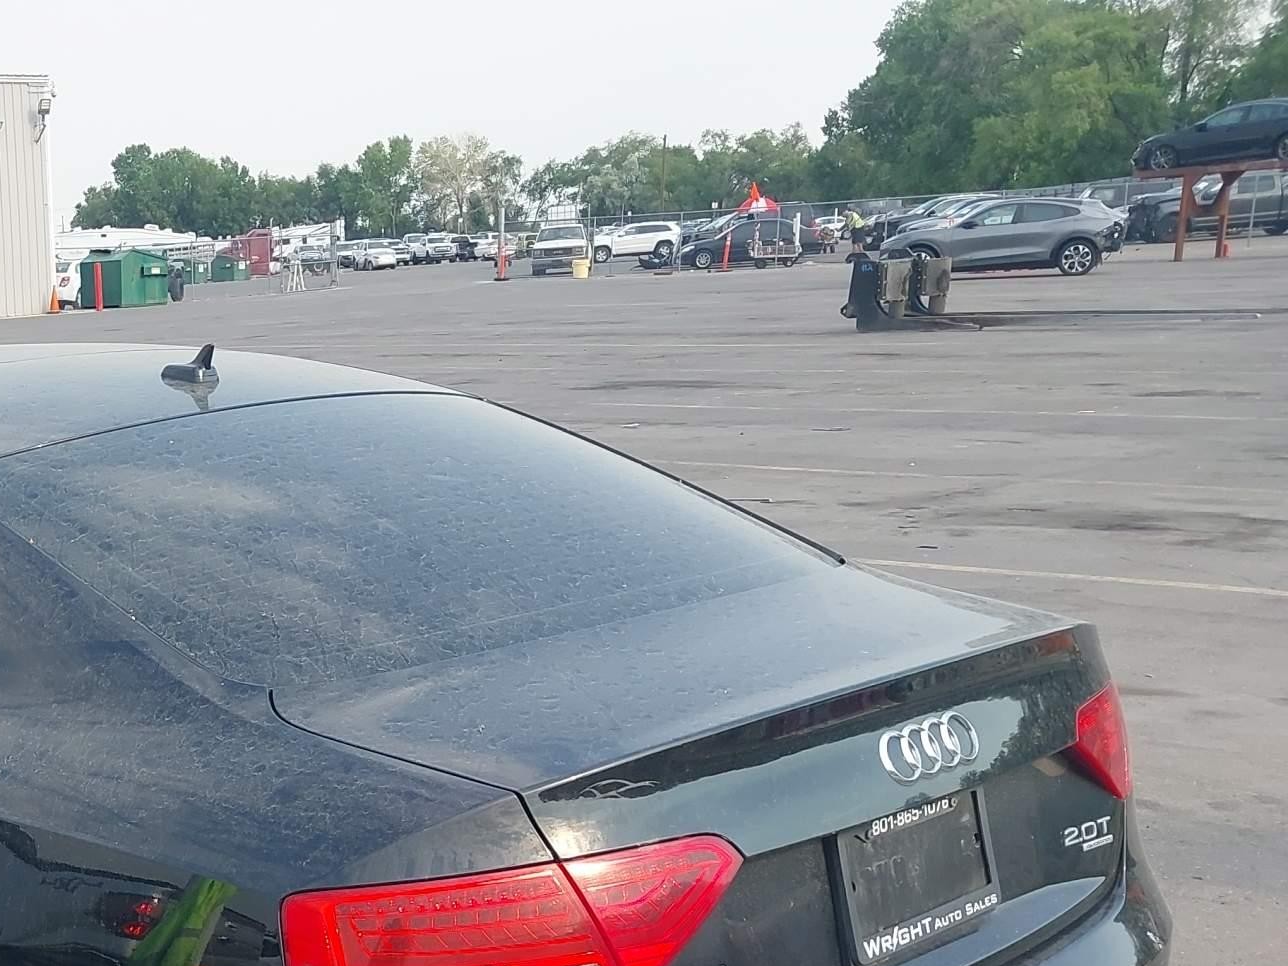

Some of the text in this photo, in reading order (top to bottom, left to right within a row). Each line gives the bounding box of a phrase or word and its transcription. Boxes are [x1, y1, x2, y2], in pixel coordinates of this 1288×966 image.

[1064, 815, 1111, 847] 2.0T
[862, 917, 933, 959] WRIGHT
[934, 908, 963, 931] AUTO
